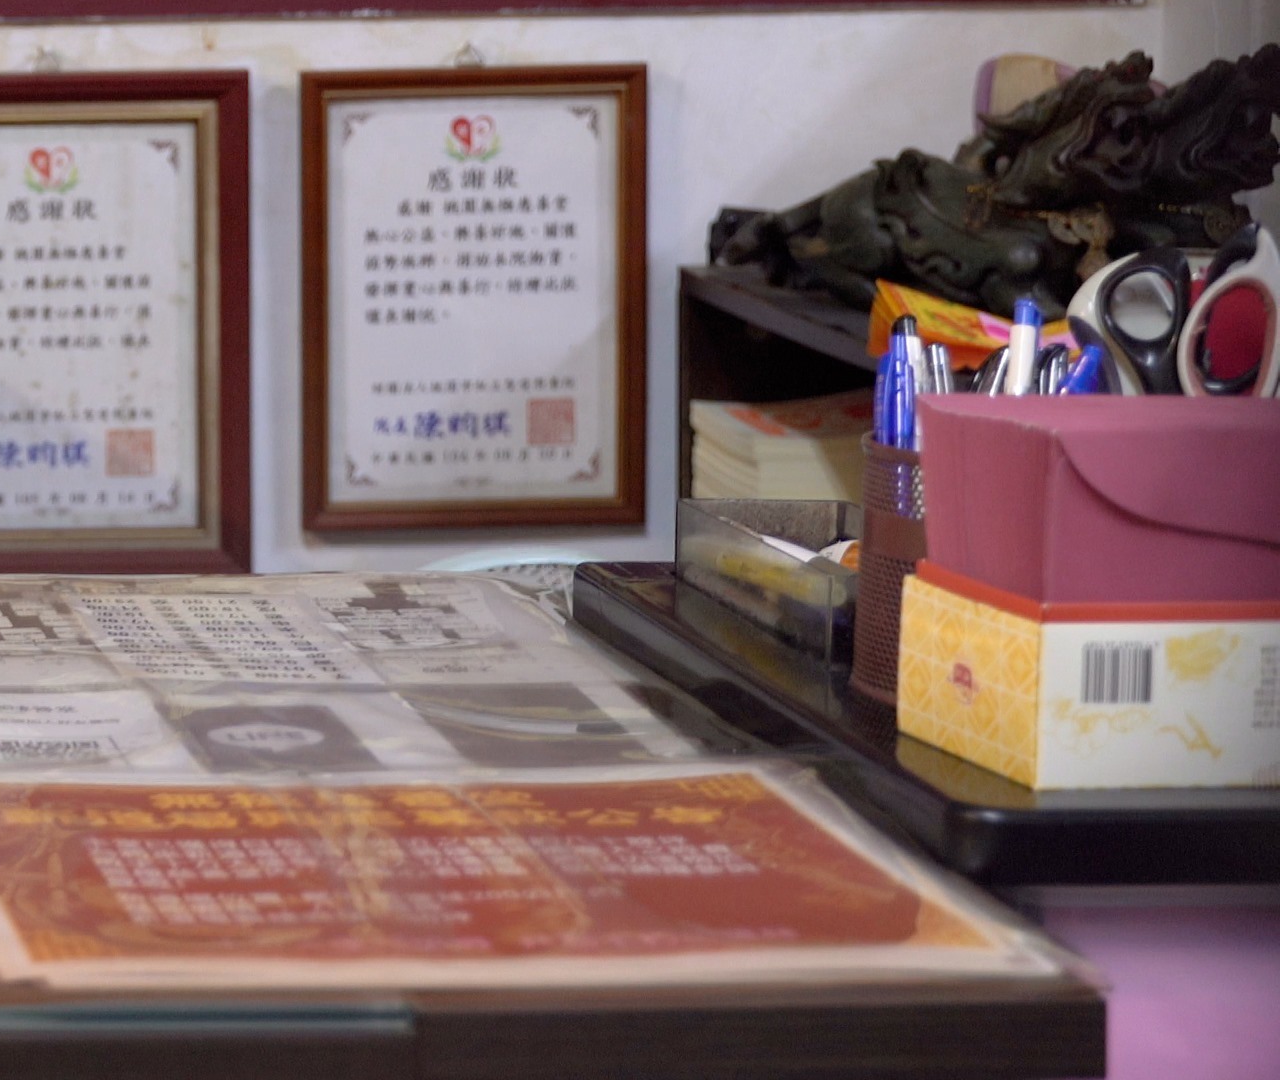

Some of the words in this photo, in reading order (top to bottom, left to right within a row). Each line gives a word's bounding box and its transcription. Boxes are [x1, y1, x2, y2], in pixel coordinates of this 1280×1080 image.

[427, 166, 519, 193] 感謝狀
[5, 197, 98, 224] 感謝狀
